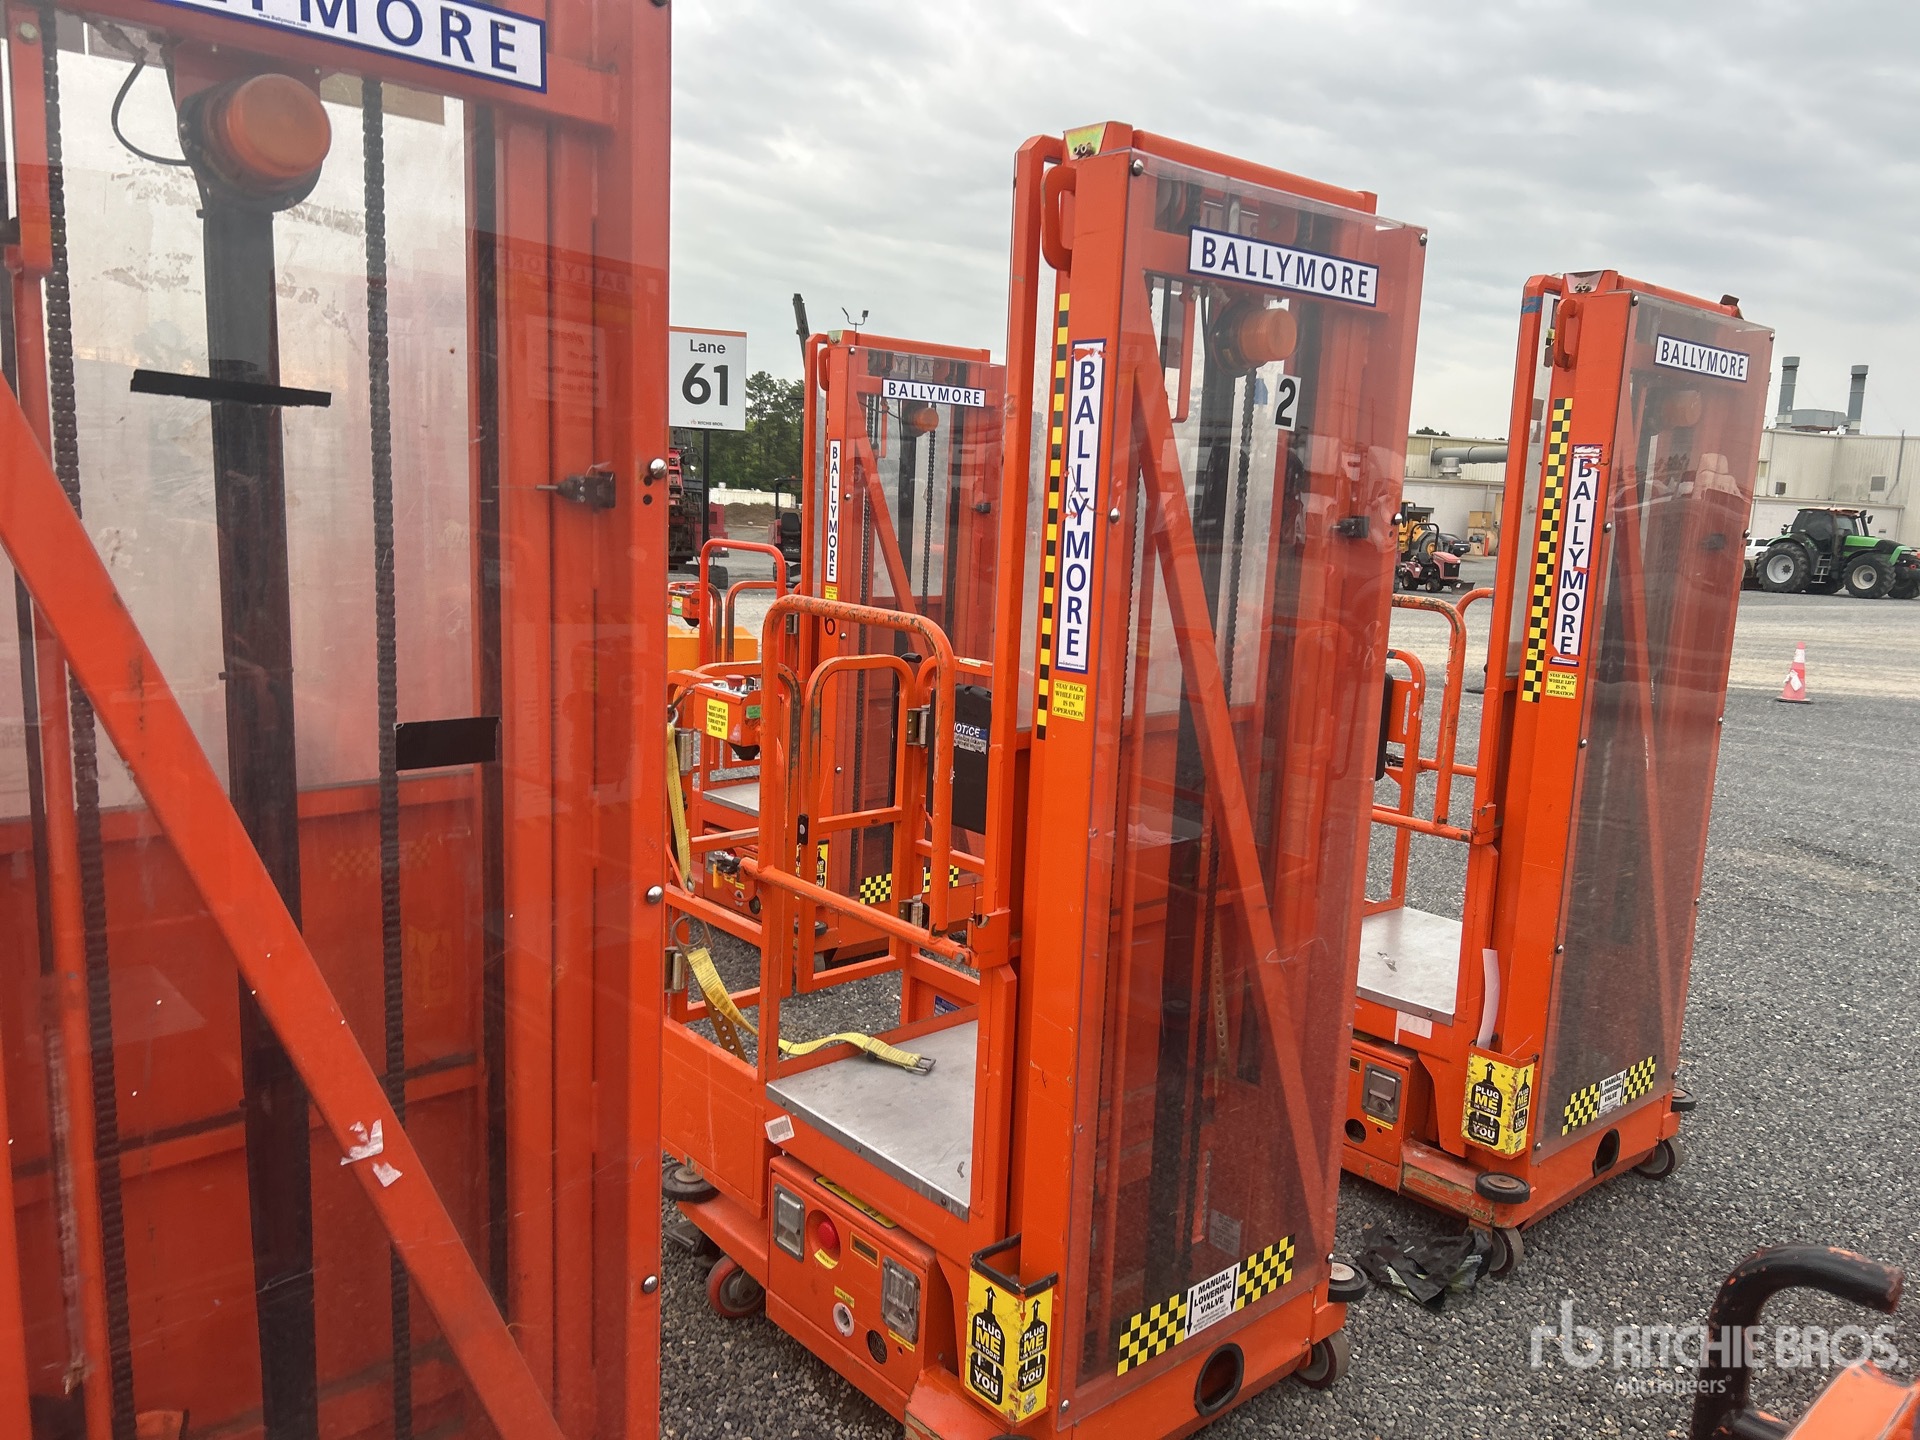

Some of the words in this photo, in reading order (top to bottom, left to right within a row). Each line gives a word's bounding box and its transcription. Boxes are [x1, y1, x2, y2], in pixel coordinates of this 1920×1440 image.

[219, 0, 517, 74] MORE
[1202, 237, 1369, 298] BALLYMORE
[690, 339, 726, 354] Lane
[1661, 340, 1745, 378] BALLYMORE
[682, 363, 729, 406] 61
[888, 382, 981, 405] BALLYMORE
[1275, 378, 1296, 427] 2
[828, 446, 839, 577] BALLYMORE
[1066, 361, 1096, 657] BALLYMORE
[1560, 458, 1594, 654] BALLYMORE
[1055, 691, 1072, 699] WHILE
[1053, 706, 1084, 717] OPERATION
[1475, 1093, 1498, 1110] ME
[1476, 1085, 1499, 1099] PLUG
[1518, 1095, 1528, 1106] ME
[1473, 1124, 1495, 1139] YOU
[1194, 1280, 1232, 1307] LOWERING
[1198, 1272, 1230, 1295] MANUAL
[1200, 1295, 1224, 1314] VALVE
[976, 1316, 1001, 1340] PLUG
[1024, 1325, 1045, 1341] PLUG
[975, 1341, 981, 1350] IN
[982, 1346, 1000, 1362] TODAY
[976, 1326, 1000, 1356] ME
[1024, 1333, 1044, 1354] ME
[974, 1370, 999, 1395] YOU
[1022, 1368, 1042, 1385] YOU
